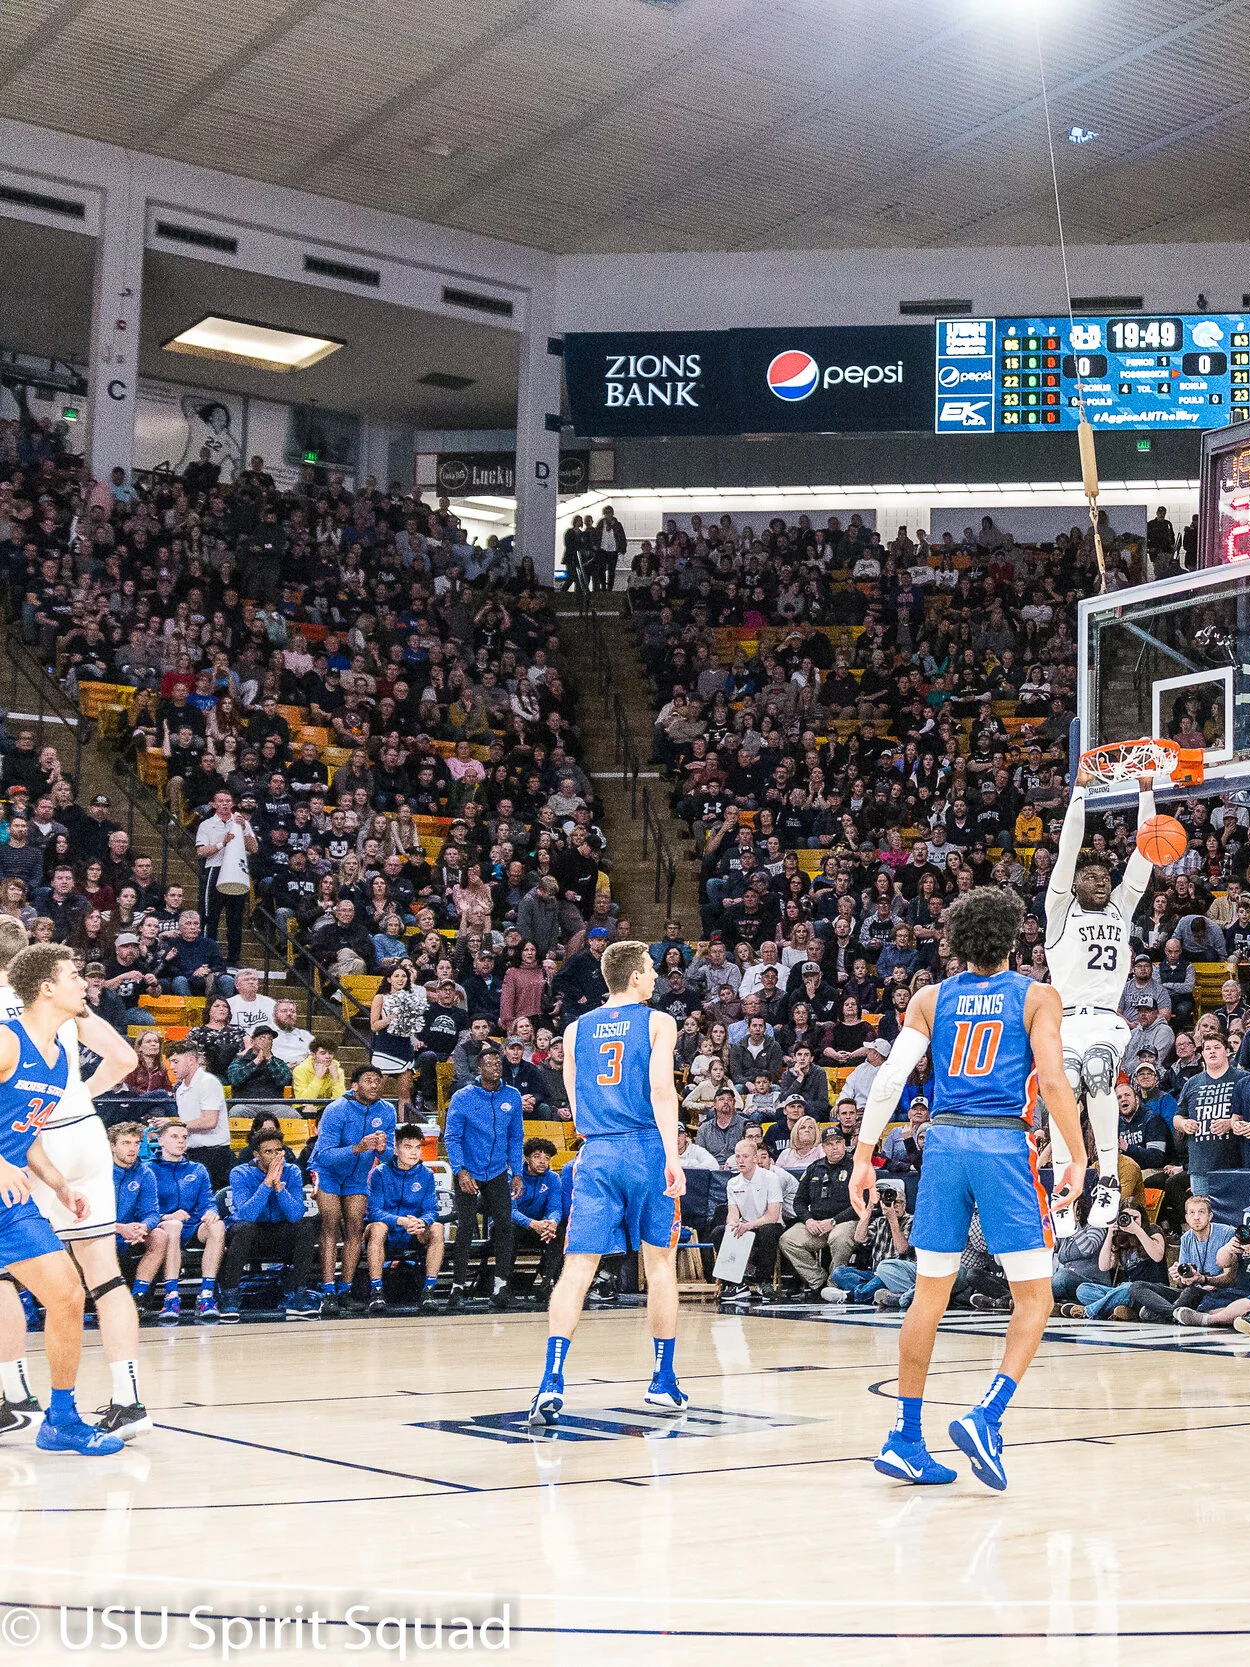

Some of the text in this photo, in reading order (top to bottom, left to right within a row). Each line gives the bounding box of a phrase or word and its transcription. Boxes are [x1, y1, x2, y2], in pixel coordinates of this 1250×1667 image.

[1112, 322, 1176, 348] 19:49
[604, 354, 701, 379] ZIONS
[1004, 357, 1019, 369] 15
[1078, 357, 1090, 376] 0
[1160, 357, 1167, 366] 1
[1198, 355, 1211, 374] 0
[823, 361, 904, 389] pepsi
[960, 370, 992, 383] pepsi
[1004, 376, 1019, 387] 22
[1234, 372, 1248, 383] 21
[107, 379, 127, 401] C
[604, 381, 699, 407] BANK
[1121, 384, 1130, 393] 4
[1160, 383, 1169, 392] 4
[1234, 390, 1248, 401] 23
[1004, 394, 1019, 405] 23
[1212, 395, 1220, 404] 0
[1004, 412, 1019, 424] 34
[472, 466, 513, 488] Lucky
[535, 461, 550, 480] D
[1088, 785, 1110, 796] SPALDING
[1079, 923, 1122, 942] STATE
[1087, 943, 1118, 971] 23
[956, 993, 1005, 1016] DENNIS
[1079, 1007, 1089, 1015] A
[243, 1009, 269, 1024] State
[592, 1020, 631, 1039] JESSUP
[948, 1020, 1004, 1077] 10
[597, 1040, 625, 1086] 3
[11, 1097, 57, 1137] 34
[1195, 1103, 1232, 1120] TRUE
